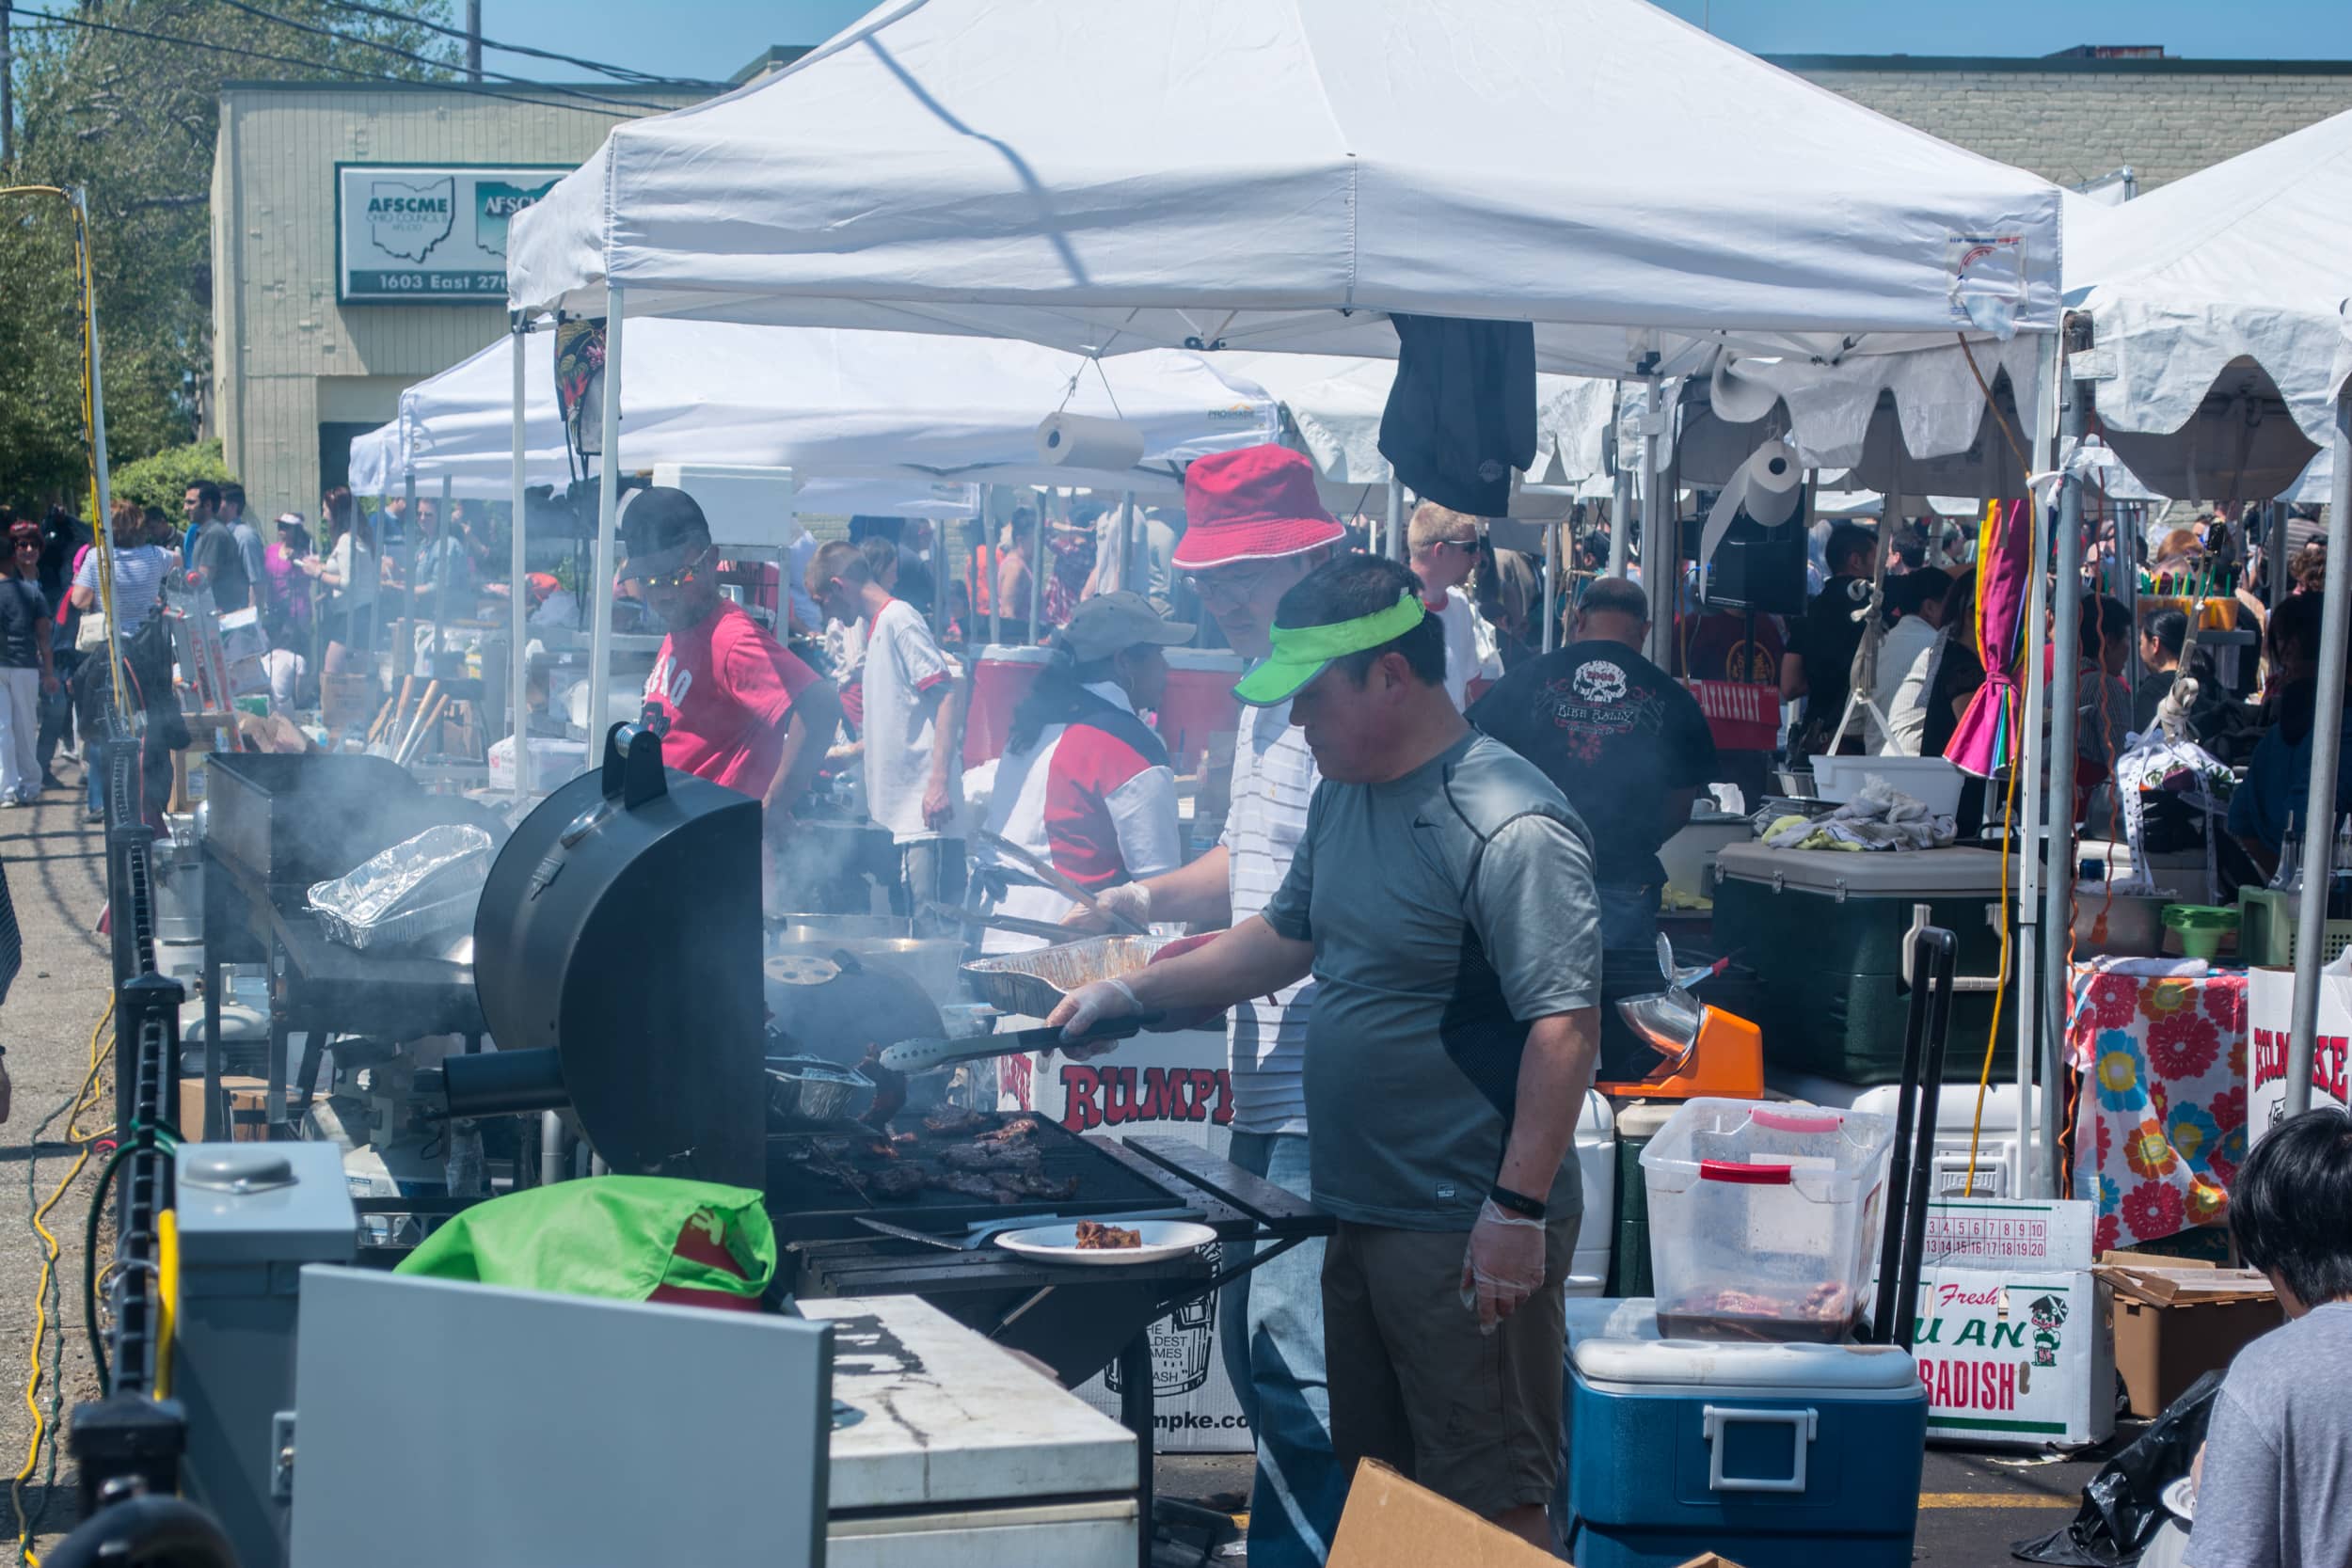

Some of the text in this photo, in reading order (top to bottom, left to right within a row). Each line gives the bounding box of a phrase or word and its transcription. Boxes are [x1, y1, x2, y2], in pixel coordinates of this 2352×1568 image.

[368, 198, 447, 213] AFSCME
[485, 196, 536, 214] AFSC
[380, 275, 506, 290] 1603 East 27t
[2254, 1027, 2349, 1106] RUKE
[1060, 1065, 1234, 1132] RUMP
[1929, 1221, 2042, 1237] 3 4 5 6 7 8 9 10
[1926, 1241, 2043, 1257] 13 14 15 16 17 18 19 20
[1938, 1284, 1999, 1307] Fresh
[1151, 1336, 1188, 1347] DEST
